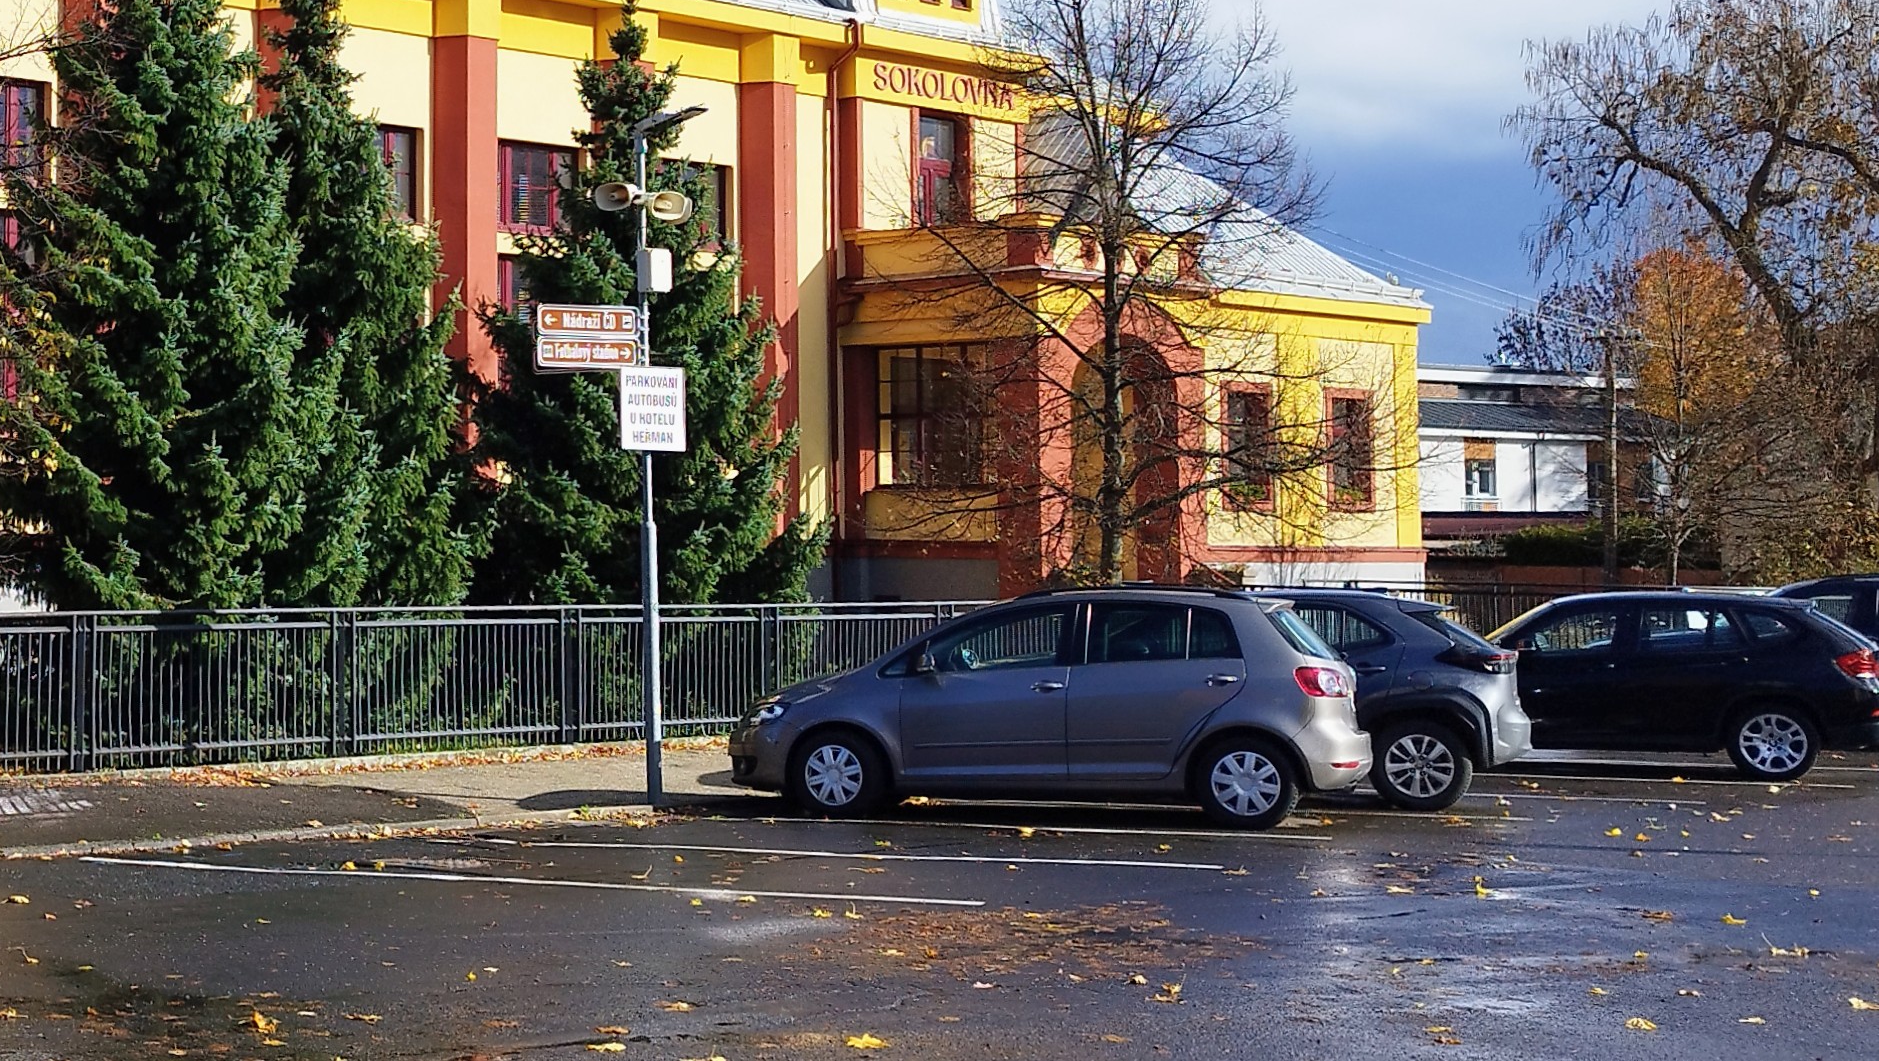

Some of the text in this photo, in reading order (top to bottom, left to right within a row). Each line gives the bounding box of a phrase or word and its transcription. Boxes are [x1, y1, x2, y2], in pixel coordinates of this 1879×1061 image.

[873, 62, 1014, 111] SOKOLOVNA
[562, 312, 601, 329] Nádraží
[625, 374, 678, 389] PARKOVÁNÍ
[628, 392, 677, 407] AUTOBUSŮ
[630, 412, 675, 426] U HOTELU
